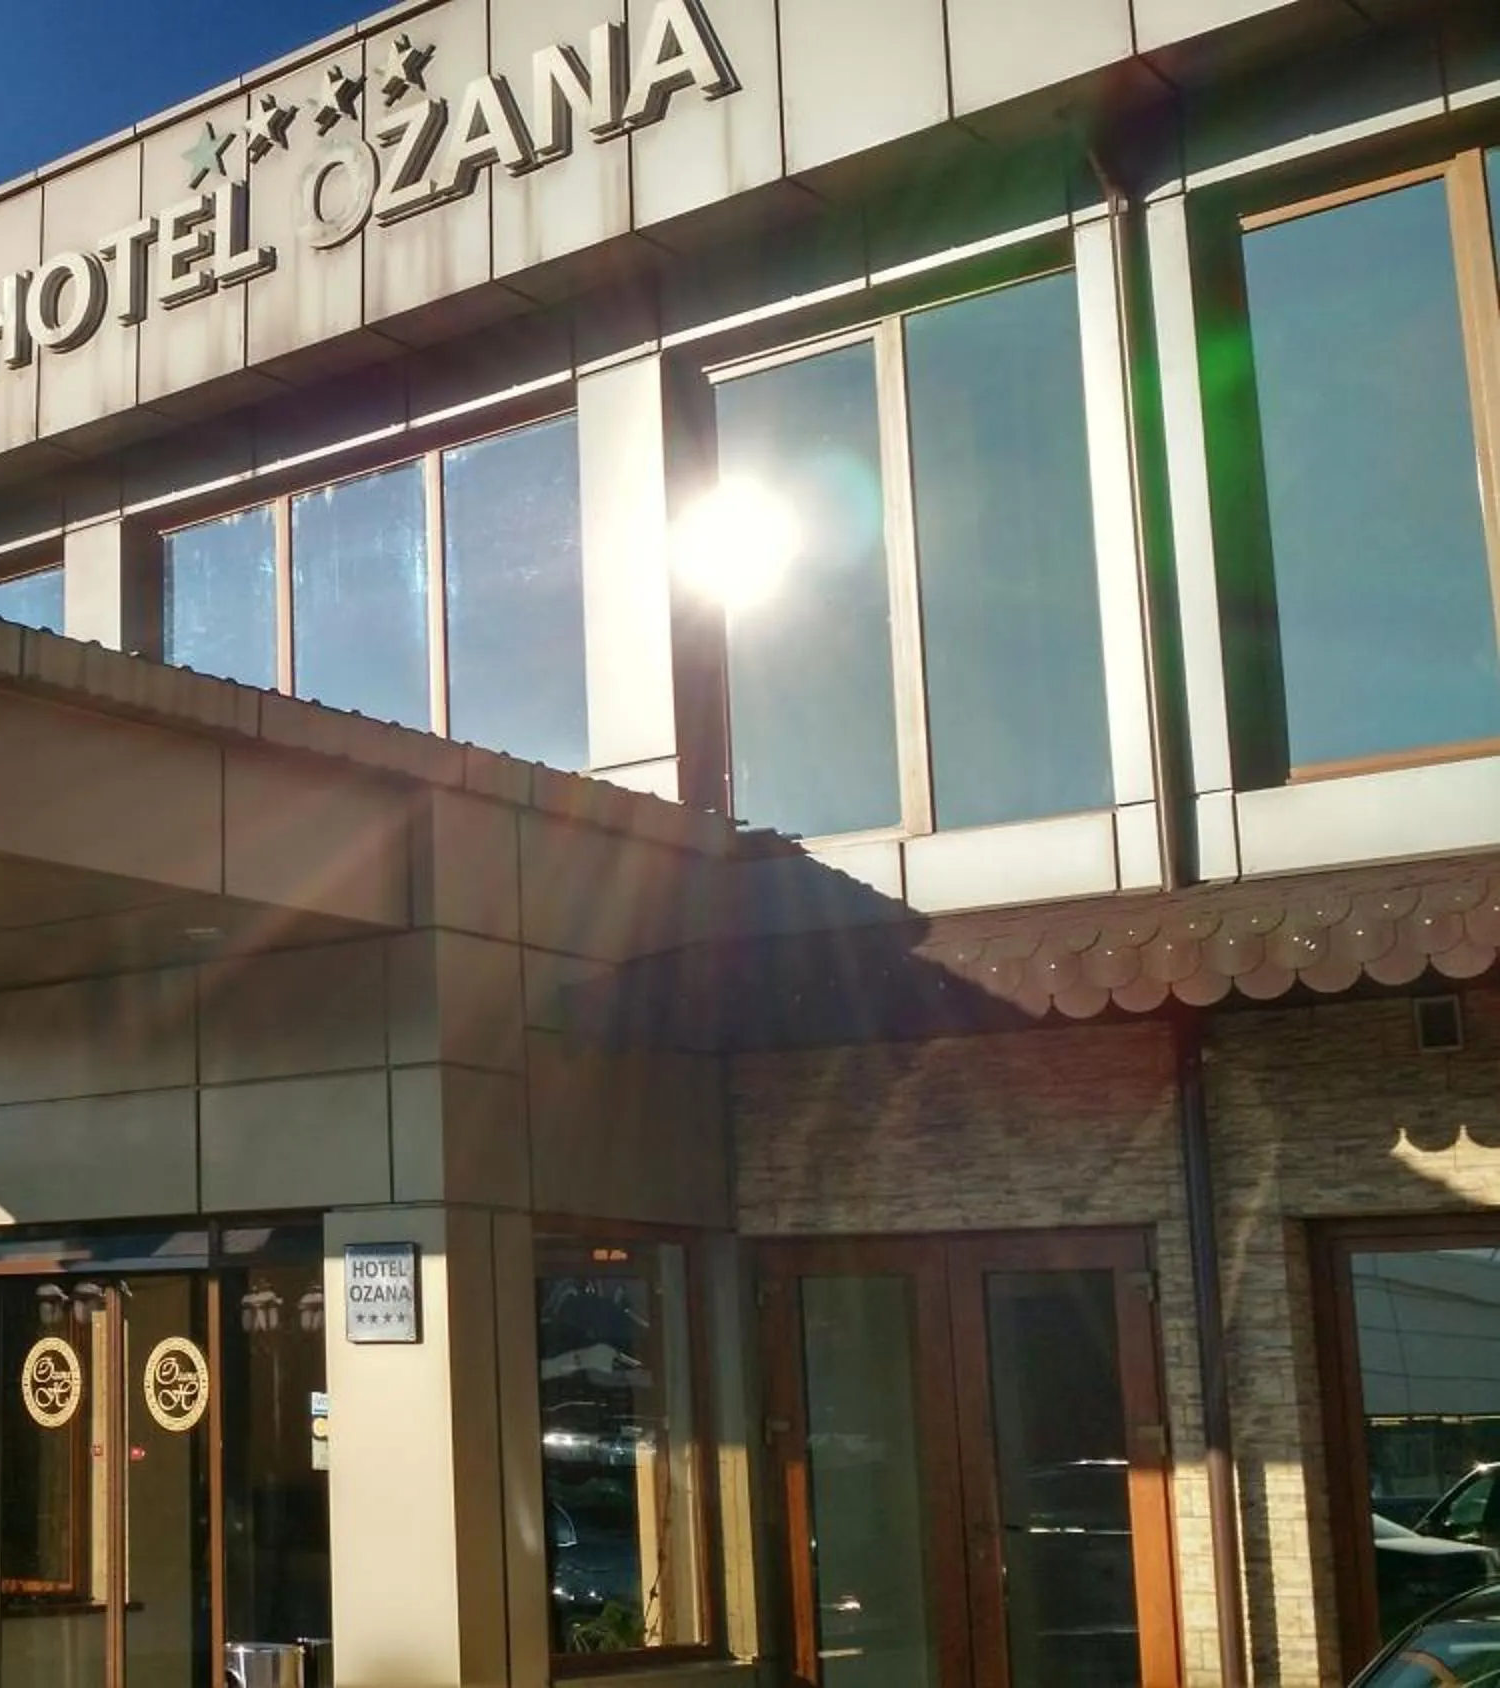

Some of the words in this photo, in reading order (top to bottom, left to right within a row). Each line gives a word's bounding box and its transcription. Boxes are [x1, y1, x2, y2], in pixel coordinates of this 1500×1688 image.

[302, 0, 742, 250] OZANA
[352, 1260, 408, 1278] HOTEL
[349, 1284, 412, 1303] OZANA
